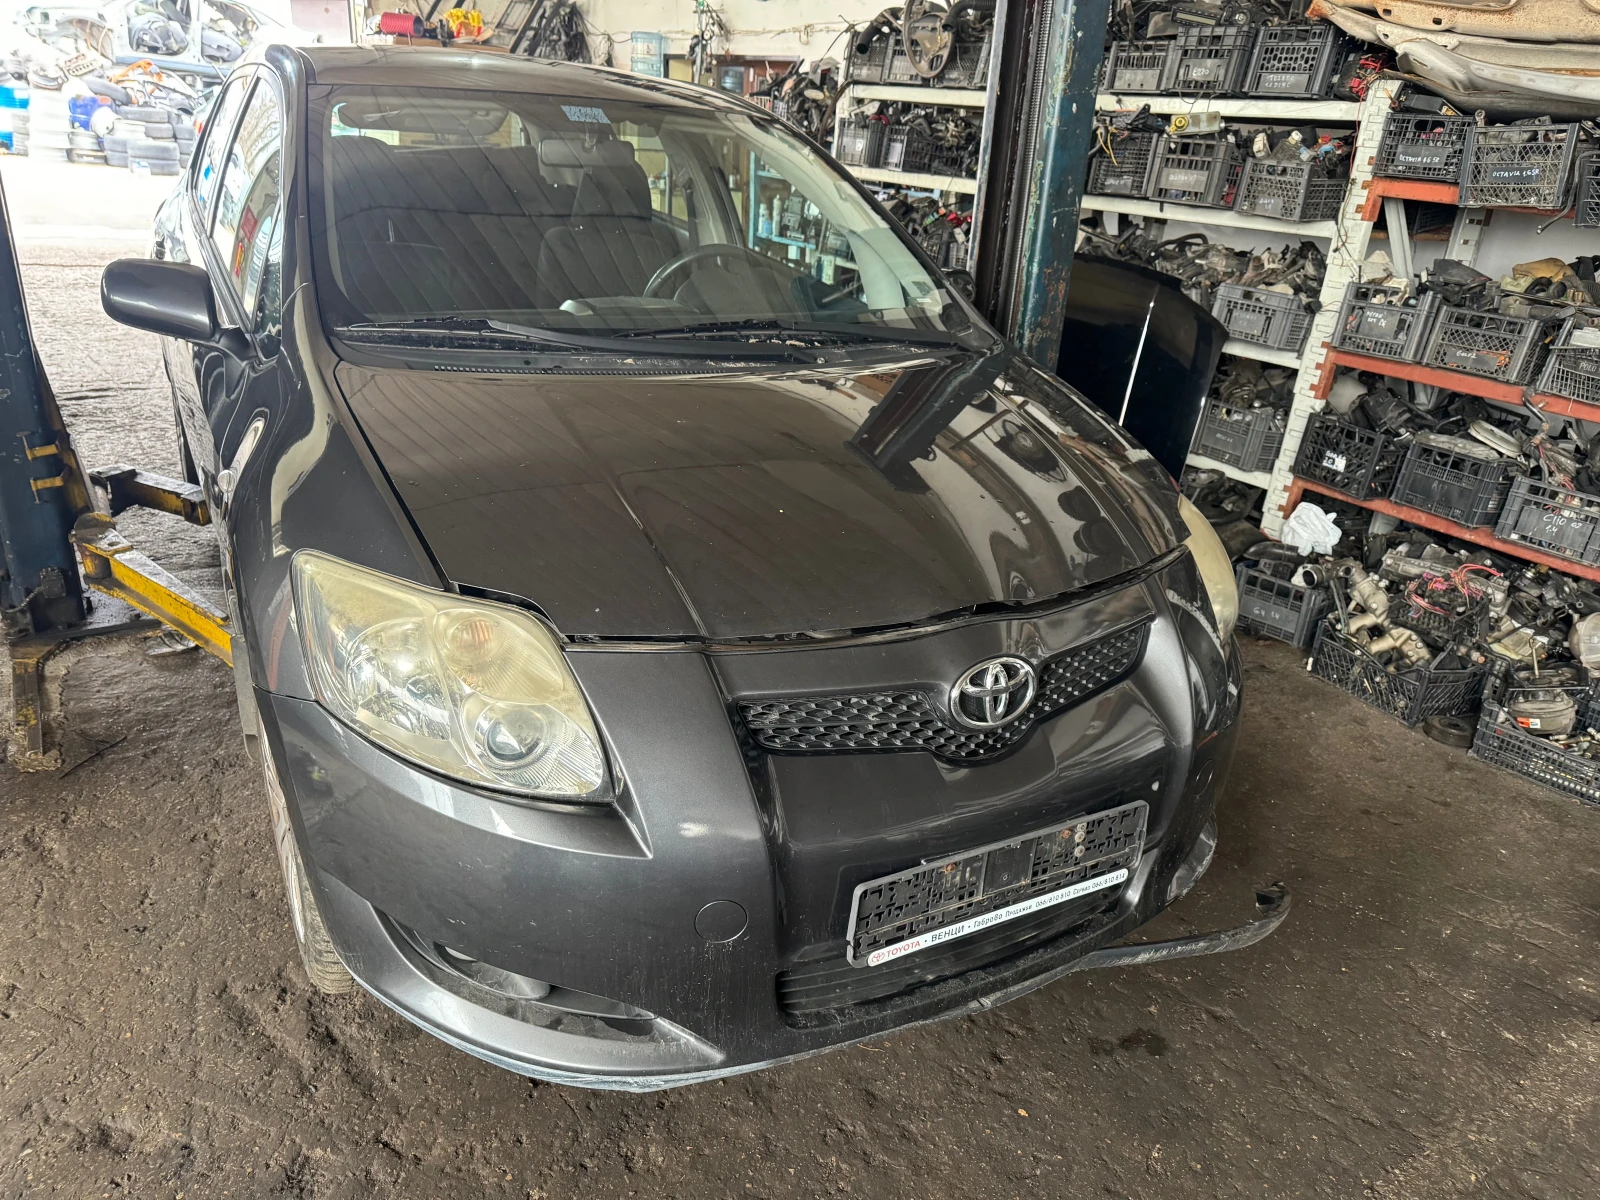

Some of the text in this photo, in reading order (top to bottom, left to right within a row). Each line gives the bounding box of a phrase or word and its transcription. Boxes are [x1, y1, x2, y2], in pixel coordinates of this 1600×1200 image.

[886, 940, 921, 957] TOYOTA
[931, 925, 965, 942] ВЕНЦИ
[973, 913, 1003, 928] Габрово
